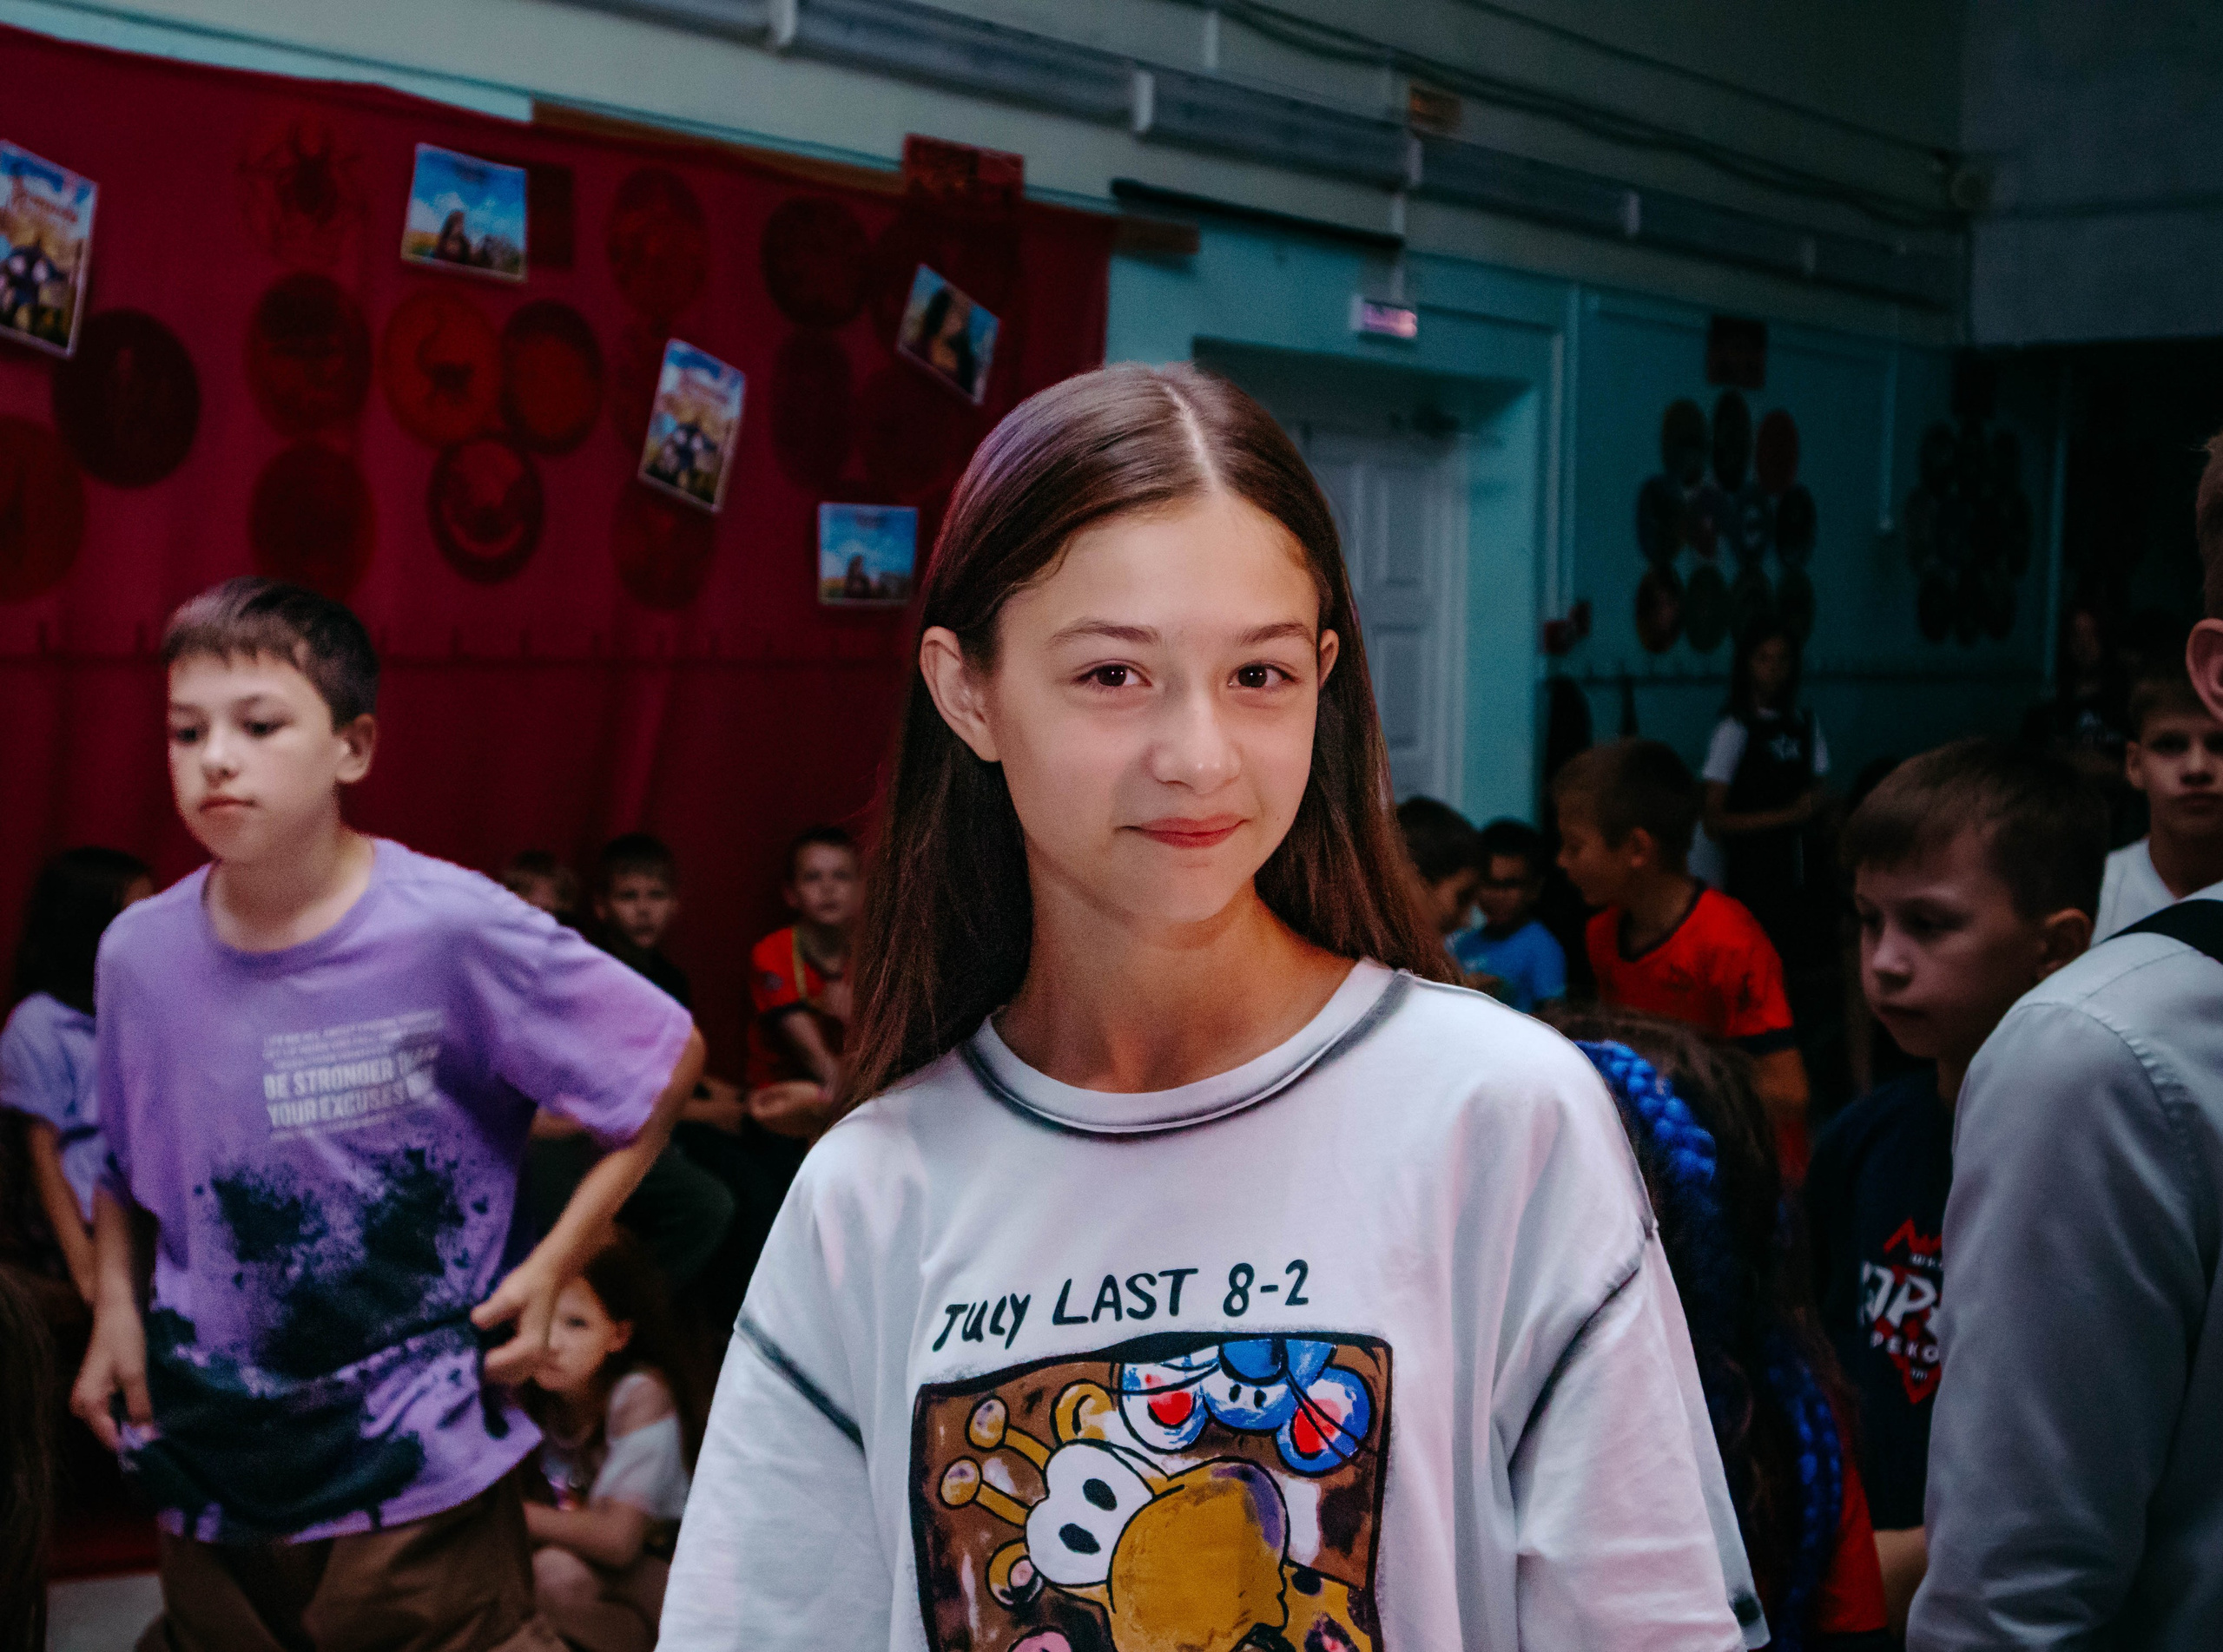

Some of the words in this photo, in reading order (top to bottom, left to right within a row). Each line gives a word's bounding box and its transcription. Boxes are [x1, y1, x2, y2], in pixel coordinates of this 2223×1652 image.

[264, 1073, 288, 1101] BE
[293, 1057, 395, 1096] STRONGER
[267, 1097, 318, 1128] YOUR
[319, 1078, 406, 1121] EXCUSES
[1052, 1267, 1199, 1326] LAST
[1223, 1259, 1309, 1317] 8-2
